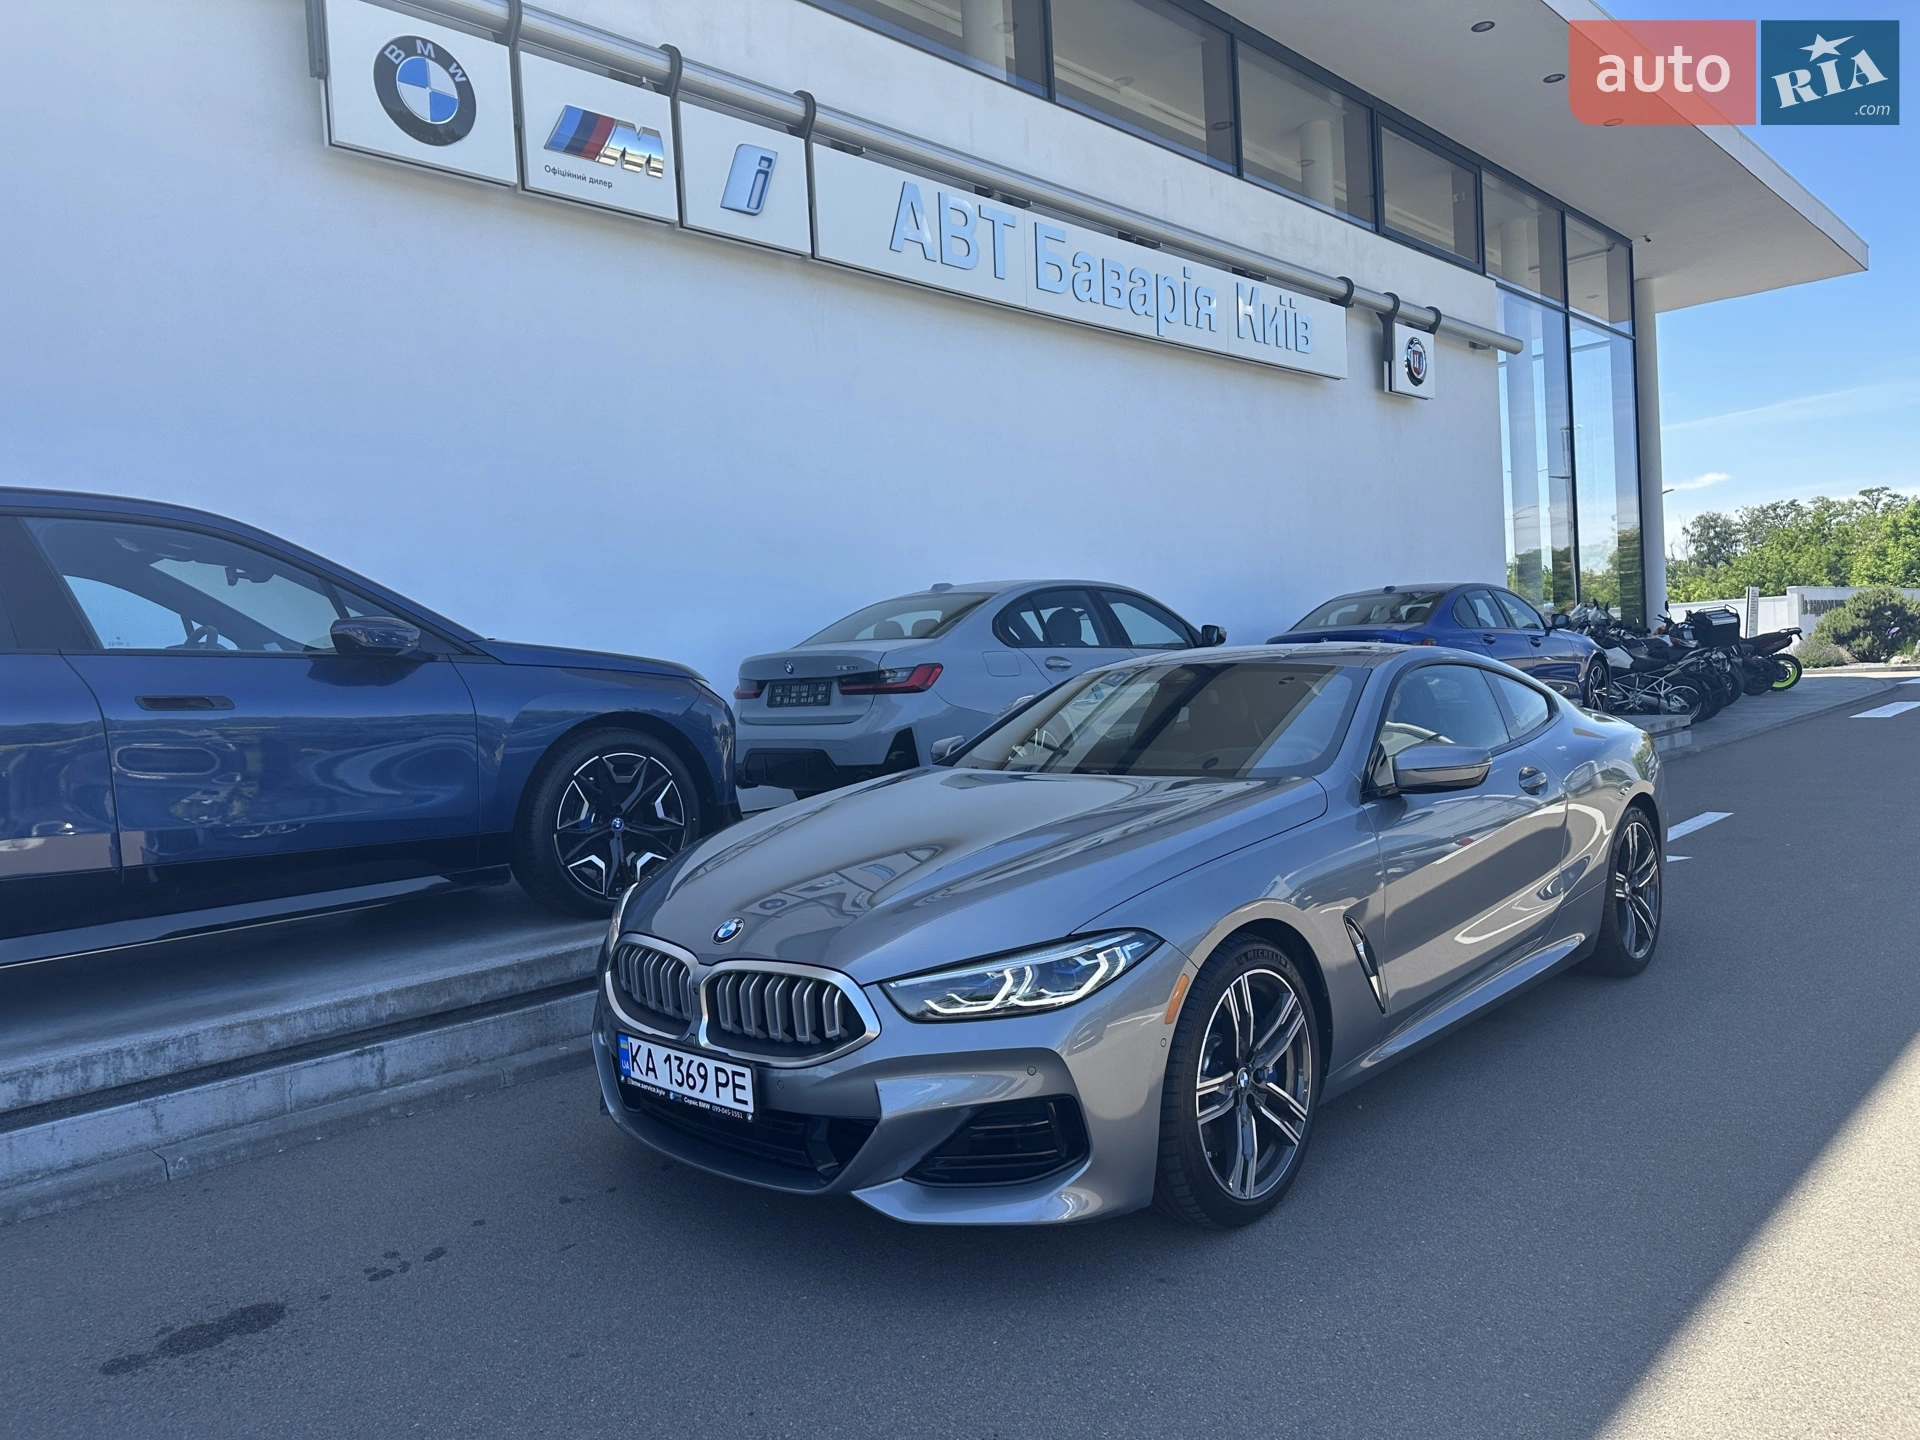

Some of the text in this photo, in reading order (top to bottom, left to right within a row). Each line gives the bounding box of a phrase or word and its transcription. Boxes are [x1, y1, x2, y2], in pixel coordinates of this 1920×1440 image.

[383, 39, 467, 82] BMW
[544, 164, 613, 189] Офіційний дилер
[889, 181, 1314, 354] АВТ Баварія Київ
[1247, 949, 1287, 967] MICHELIN
[621, 1060, 630, 1070] UA
[630, 1042, 749, 1106] KA 1369 PE
